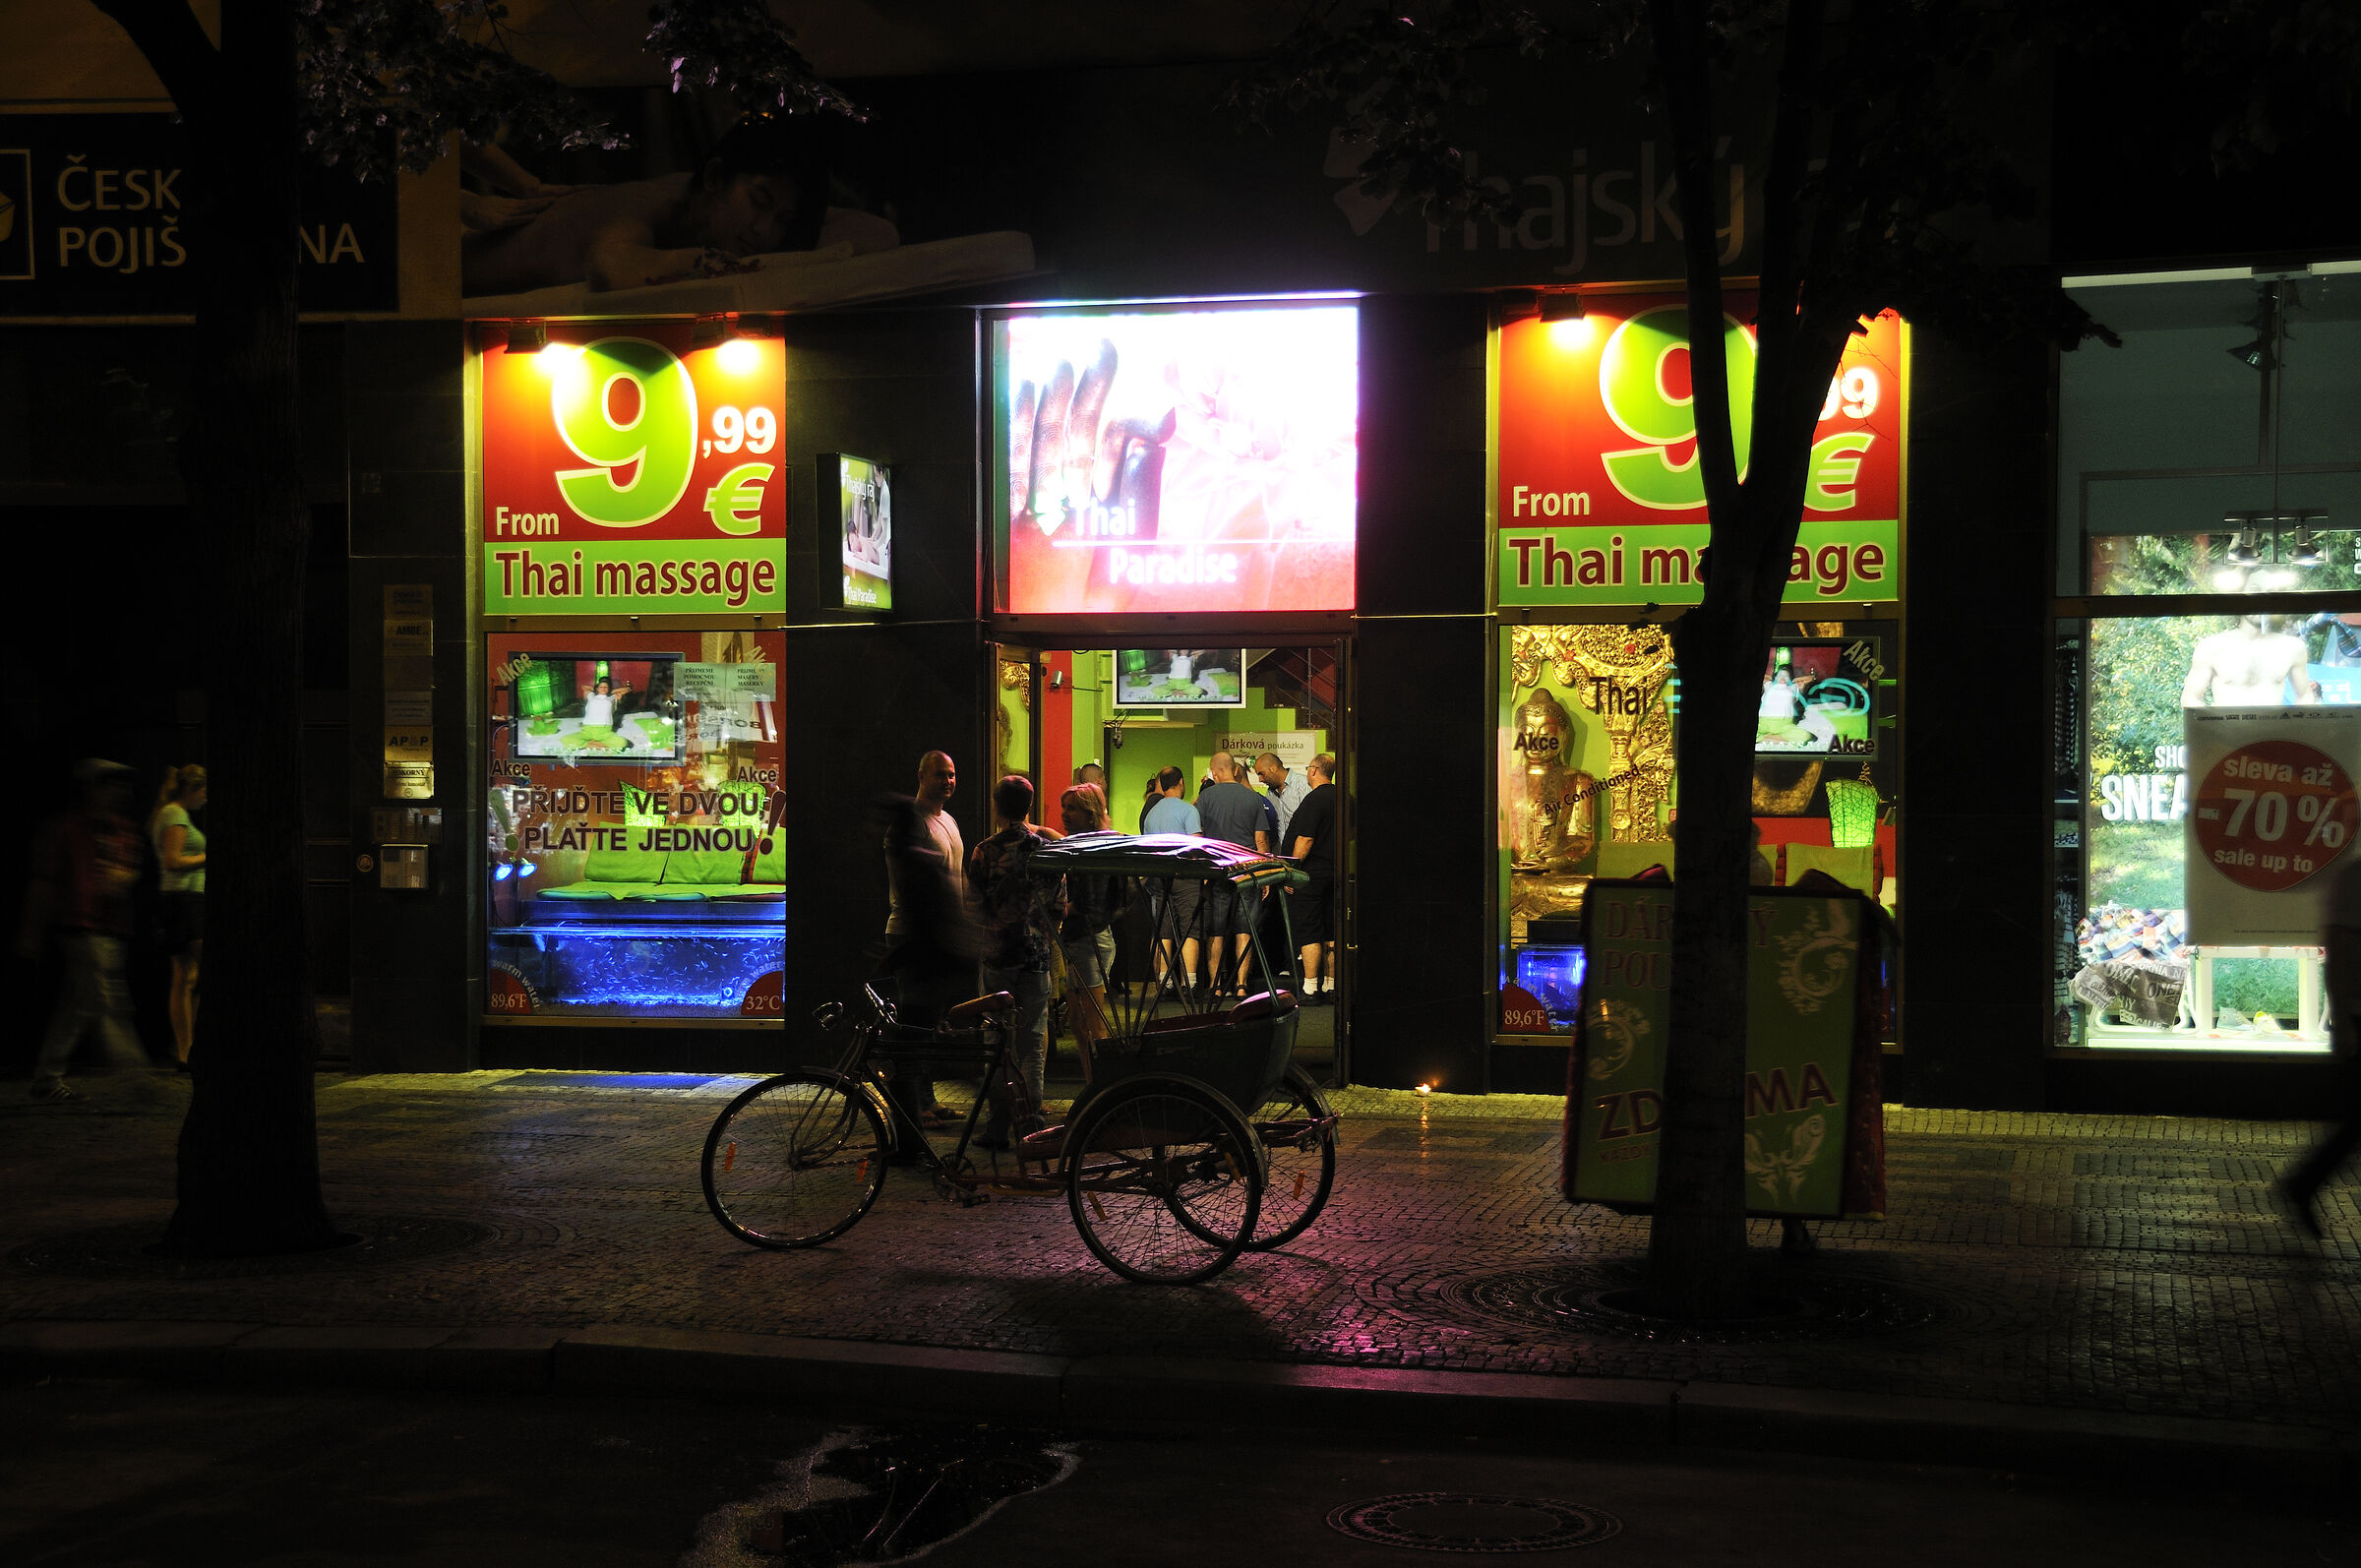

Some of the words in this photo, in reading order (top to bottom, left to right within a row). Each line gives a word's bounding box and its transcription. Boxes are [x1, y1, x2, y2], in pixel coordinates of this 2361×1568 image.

[57, 153, 184, 211] ČESK
[1070, 497, 1136, 536] Thai
[1512, 485, 1590, 516] From
[495, 506, 560, 535] From
[495, 548, 582, 598] Thai
[595, 557, 776, 608] massage
[1110, 544, 1238, 584] Paradise
[1507, 534, 1625, 588] Thai
[1640, 541, 1886, 596] mage
[496, 652, 533, 687] Akce
[1843, 639, 1885, 682] Akce
[1590, 676, 1649, 716] Thai
[1222, 739, 1265, 750] Dárková
[1267, 741, 1304, 751] poukázka
[1514, 732, 1560, 752] Akce
[1829, 734, 1876, 754] Akce
[492, 760, 531, 777] Akce
[738, 766, 777, 783] Akce
[2223, 754, 2292, 784] sleva
[2301, 763, 2333, 788] až
[512, 786, 626, 814] PŘIJĎTE
[632, 792, 670, 815] VE
[679, 791, 760, 816] DVOU
[1544, 802, 1563, 815] Air
[1563, 763, 1641, 806] Conditioned
[523, 822, 628, 852] PLAŤTE
[2213, 849, 2257, 869] sale
[2261, 856, 2287, 874] up
[2292, 856, 2313, 874] to
[1595, 1062, 1838, 1142] ZDMA
